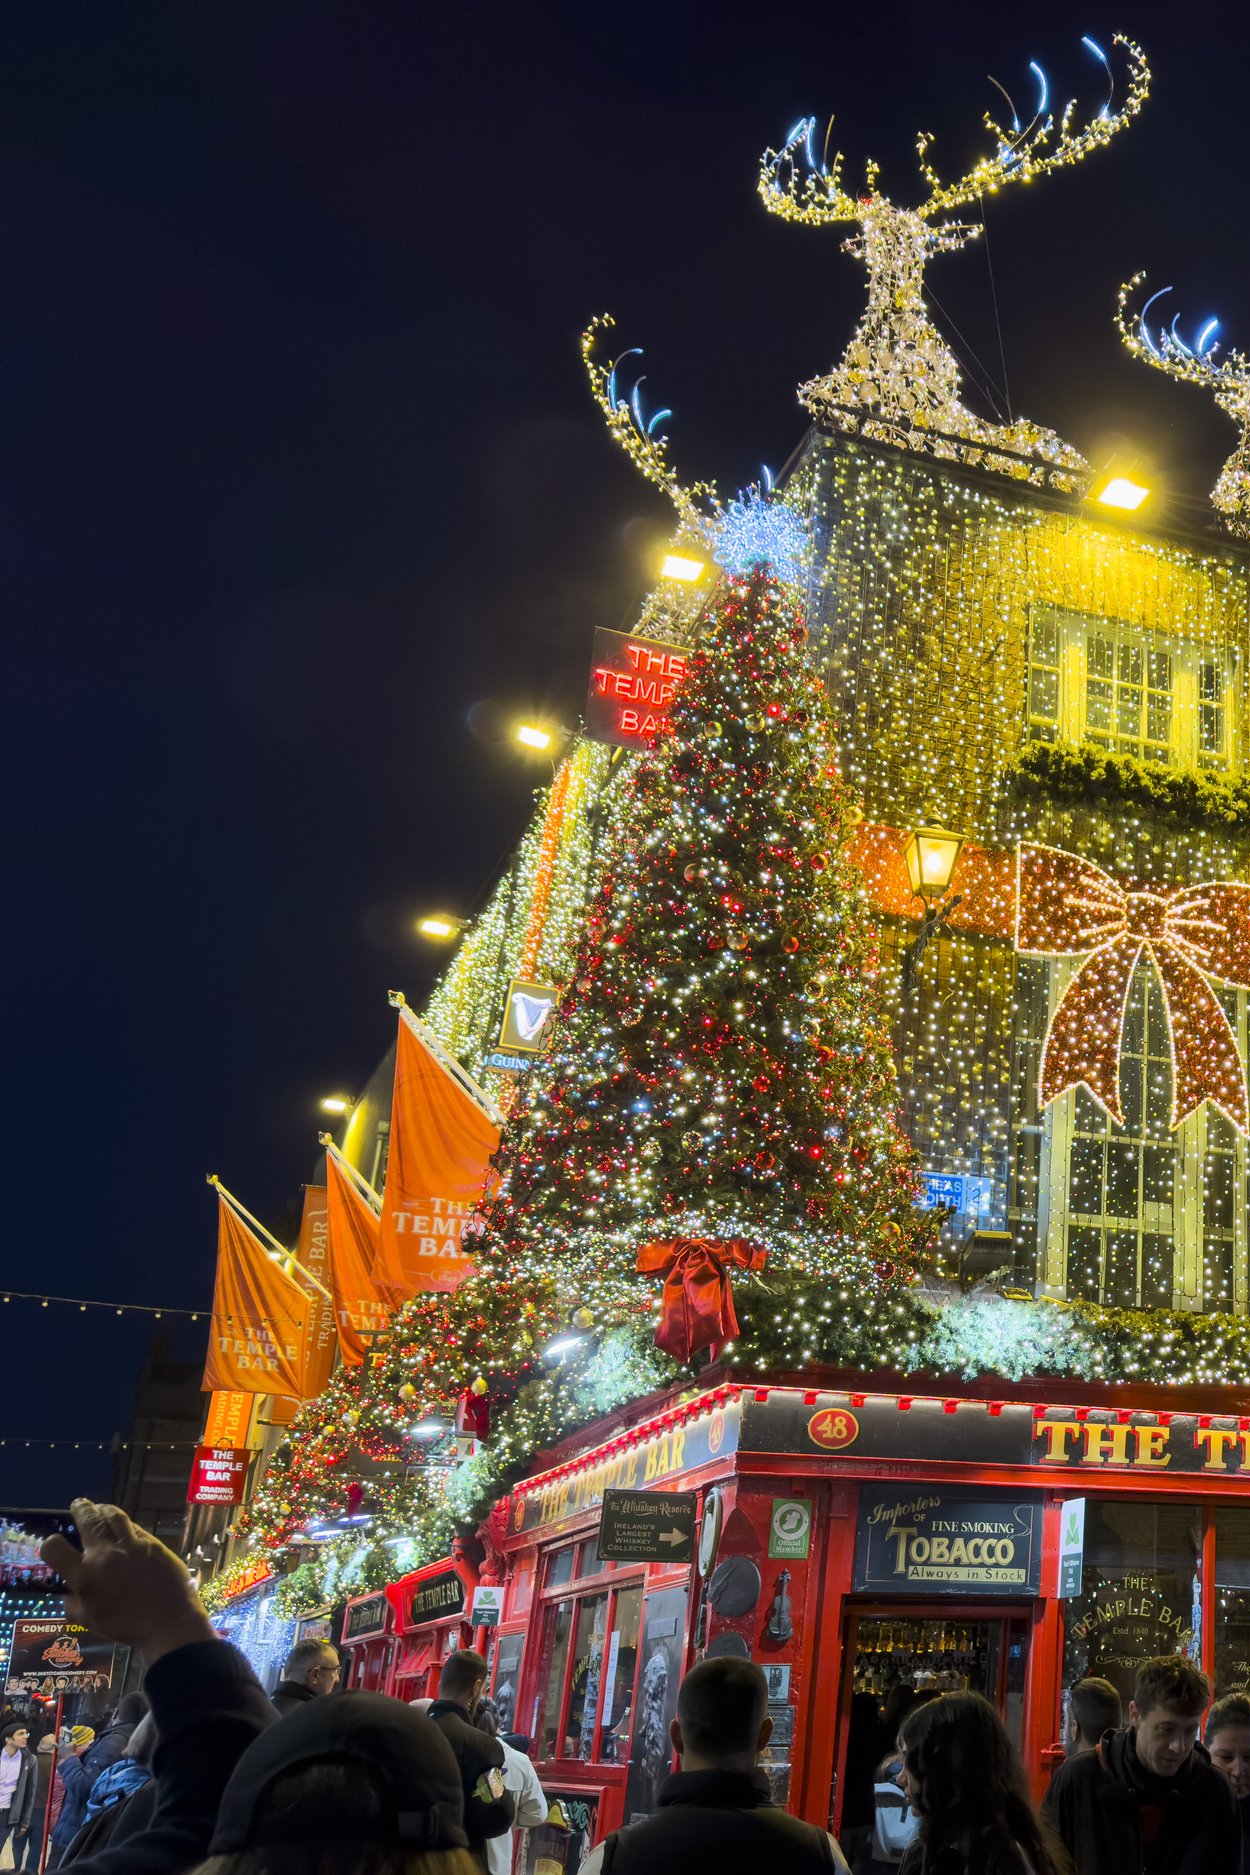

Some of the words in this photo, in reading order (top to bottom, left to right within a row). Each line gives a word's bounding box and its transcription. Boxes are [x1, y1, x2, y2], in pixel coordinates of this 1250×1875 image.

[627, 645, 688, 680] THE
[595, 668, 677, 705] TEMP
[621, 709, 657, 734] BA
[926, 1178, 962, 1193] HEAS
[418, 1237, 468, 1259] BA
[244, 1326, 277, 1343] THE
[218, 1337, 299, 1361] TEMPLE
[236, 1356, 280, 1374] BAR
[224, 1392, 244, 1447] EMPLE
[818, 1412, 849, 1440] 48
[1034, 1420, 1173, 1468] THE
[212, 1450, 235, 1462] THE
[643, 1430, 687, 1483] BAR
[199, 1459, 243, 1472] TEMPLE
[206, 1470, 231, 1482] BAR
[195, 1493, 235, 1502] COMPANY
[199, 1486, 234, 1495] TRADING
[619, 1498, 659, 1517] Whiskey
[657, 1499, 693, 1517] Reserve
[866, 1495, 942, 1527] Importers
[913, 1513, 927, 1523] OF
[613, 1522, 656, 1531] IRELAND'S
[616, 1530, 652, 1538] LARGEST
[931, 1520, 959, 1533] FINE
[960, 1520, 1016, 1535] SMOKING
[606, 1544, 658, 1553] COLLECTION
[614, 1537, 652, 1546] WHISKEY
[775, 1545, 803, 1553] Member
[909, 1565, 960, 1581] Always
[966, 1568, 980, 1580] in
[984, 1567, 1024, 1582] Stock
[1121, 1576, 1149, 1590] THE
[425, 1584, 447, 1612] TEMPLE
[446, 1580, 460, 1604] BAR
[22, 1624, 64, 1634] COMEDY
[1070, 1599, 1152, 1640] TEMPLE
[1158, 1606, 1195, 1646] BAR
[1112, 1626, 1132, 1635] Estd.
[1132, 1626, 1150, 1636] 1840
[1231, 1680, 1248, 1690] and
